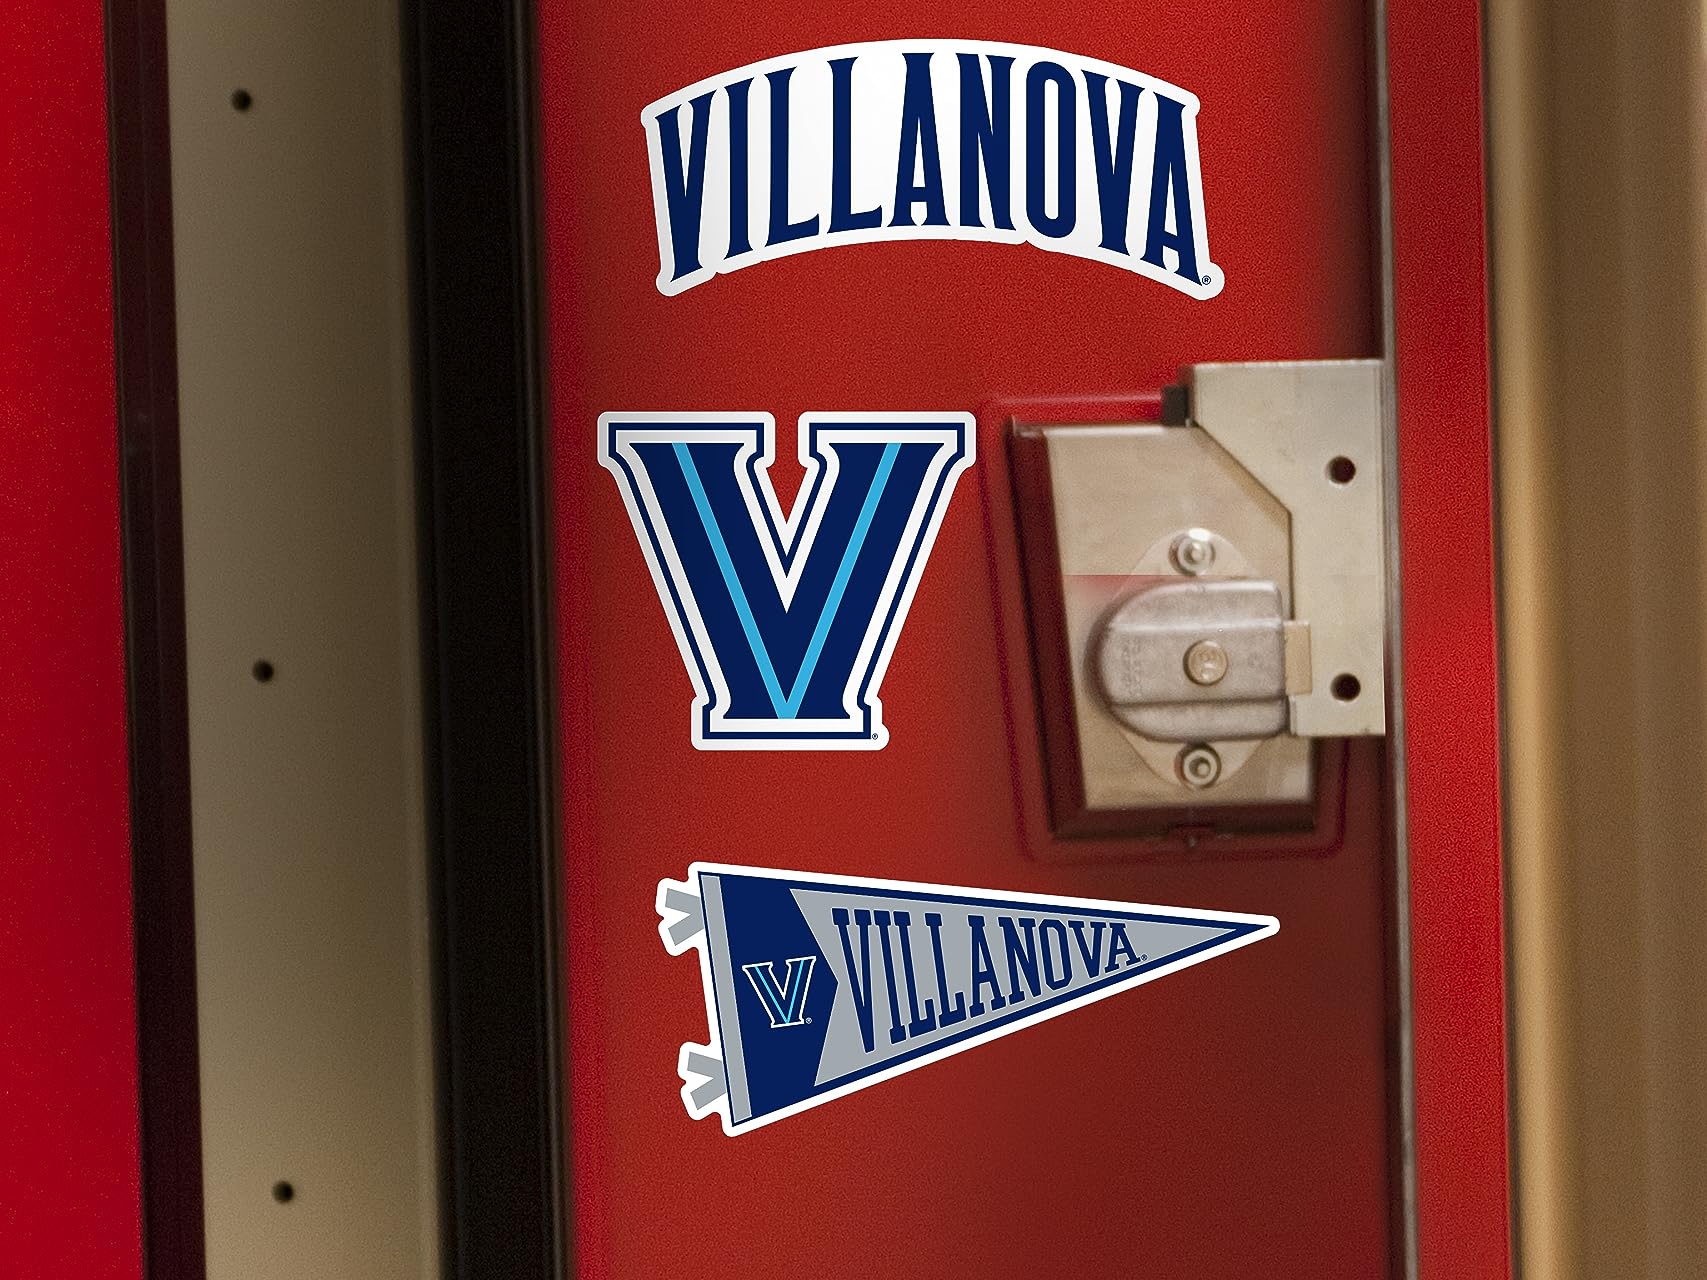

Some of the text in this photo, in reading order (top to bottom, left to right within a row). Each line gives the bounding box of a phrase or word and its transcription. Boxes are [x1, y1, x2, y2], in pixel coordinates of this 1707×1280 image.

[655, 53, 1202, 286] VILLANOVA
[608, 422, 966, 739] V
[742, 956, 817, 1028] V
[832, 907, 1141, 1054] VILLANOVA
